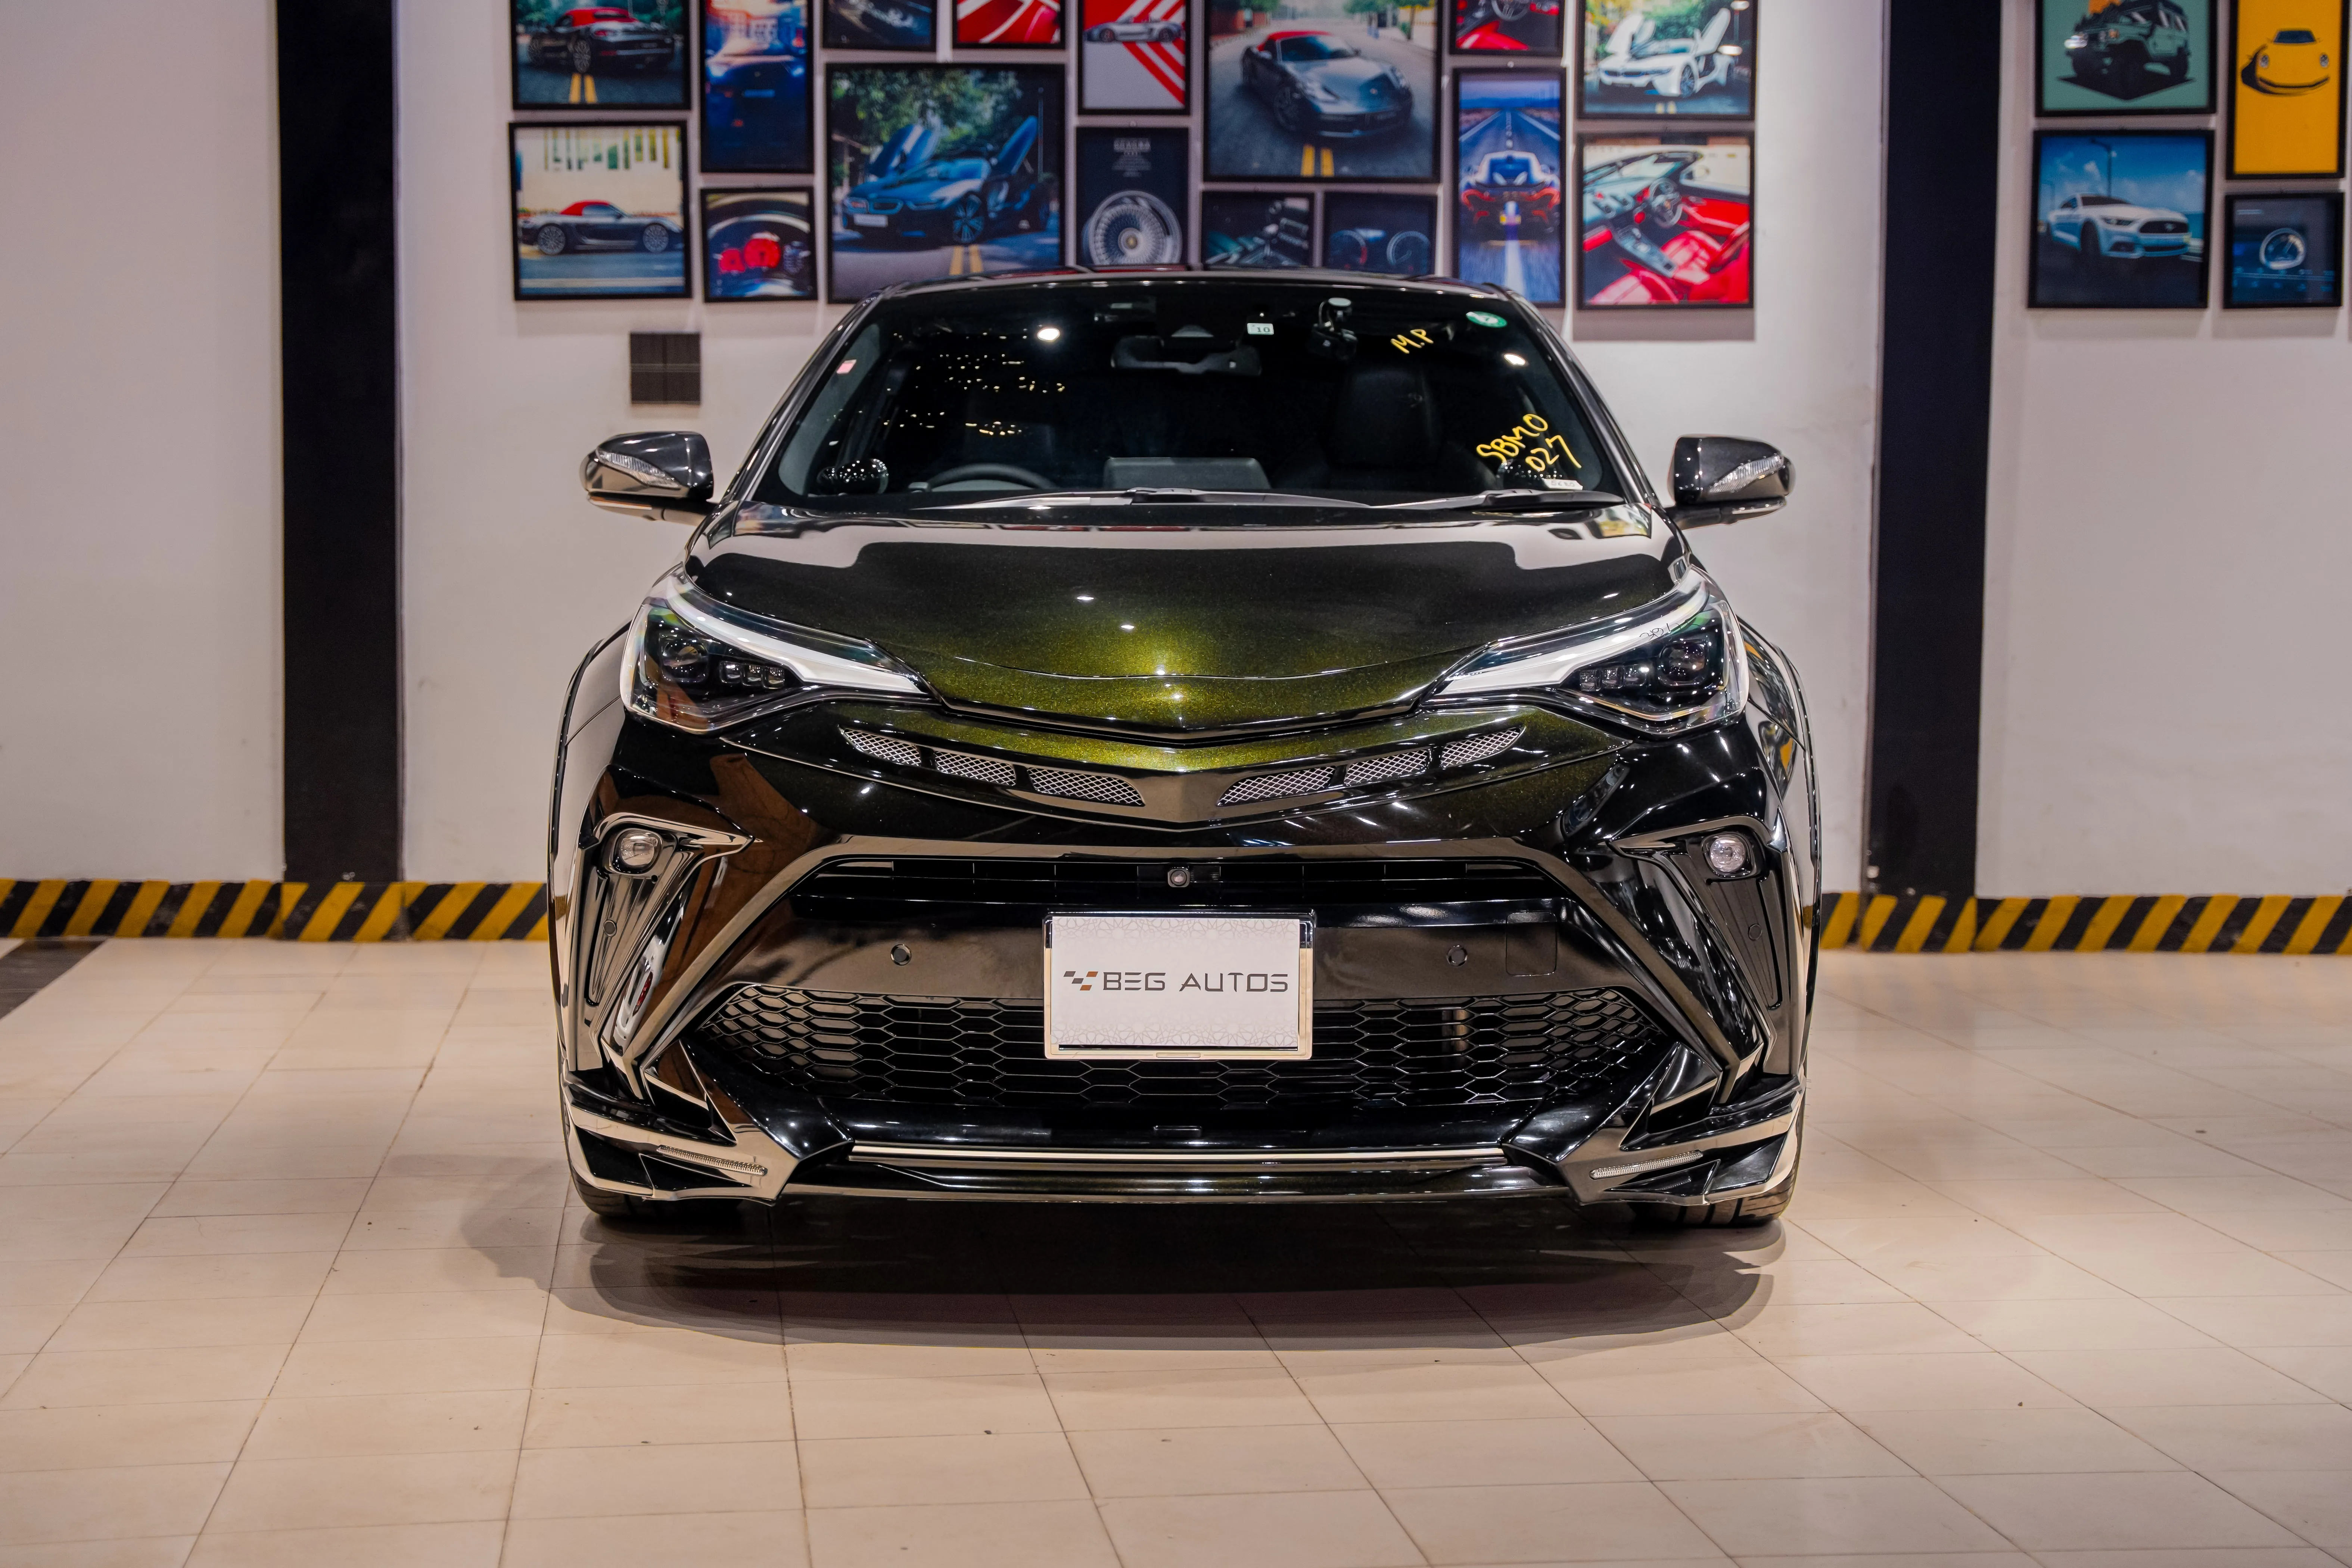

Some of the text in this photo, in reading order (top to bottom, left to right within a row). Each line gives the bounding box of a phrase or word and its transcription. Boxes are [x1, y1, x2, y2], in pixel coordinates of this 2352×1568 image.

[1525, 435, 1582, 472] 027
[1103, 972, 1288, 993] BEG AUTOS
